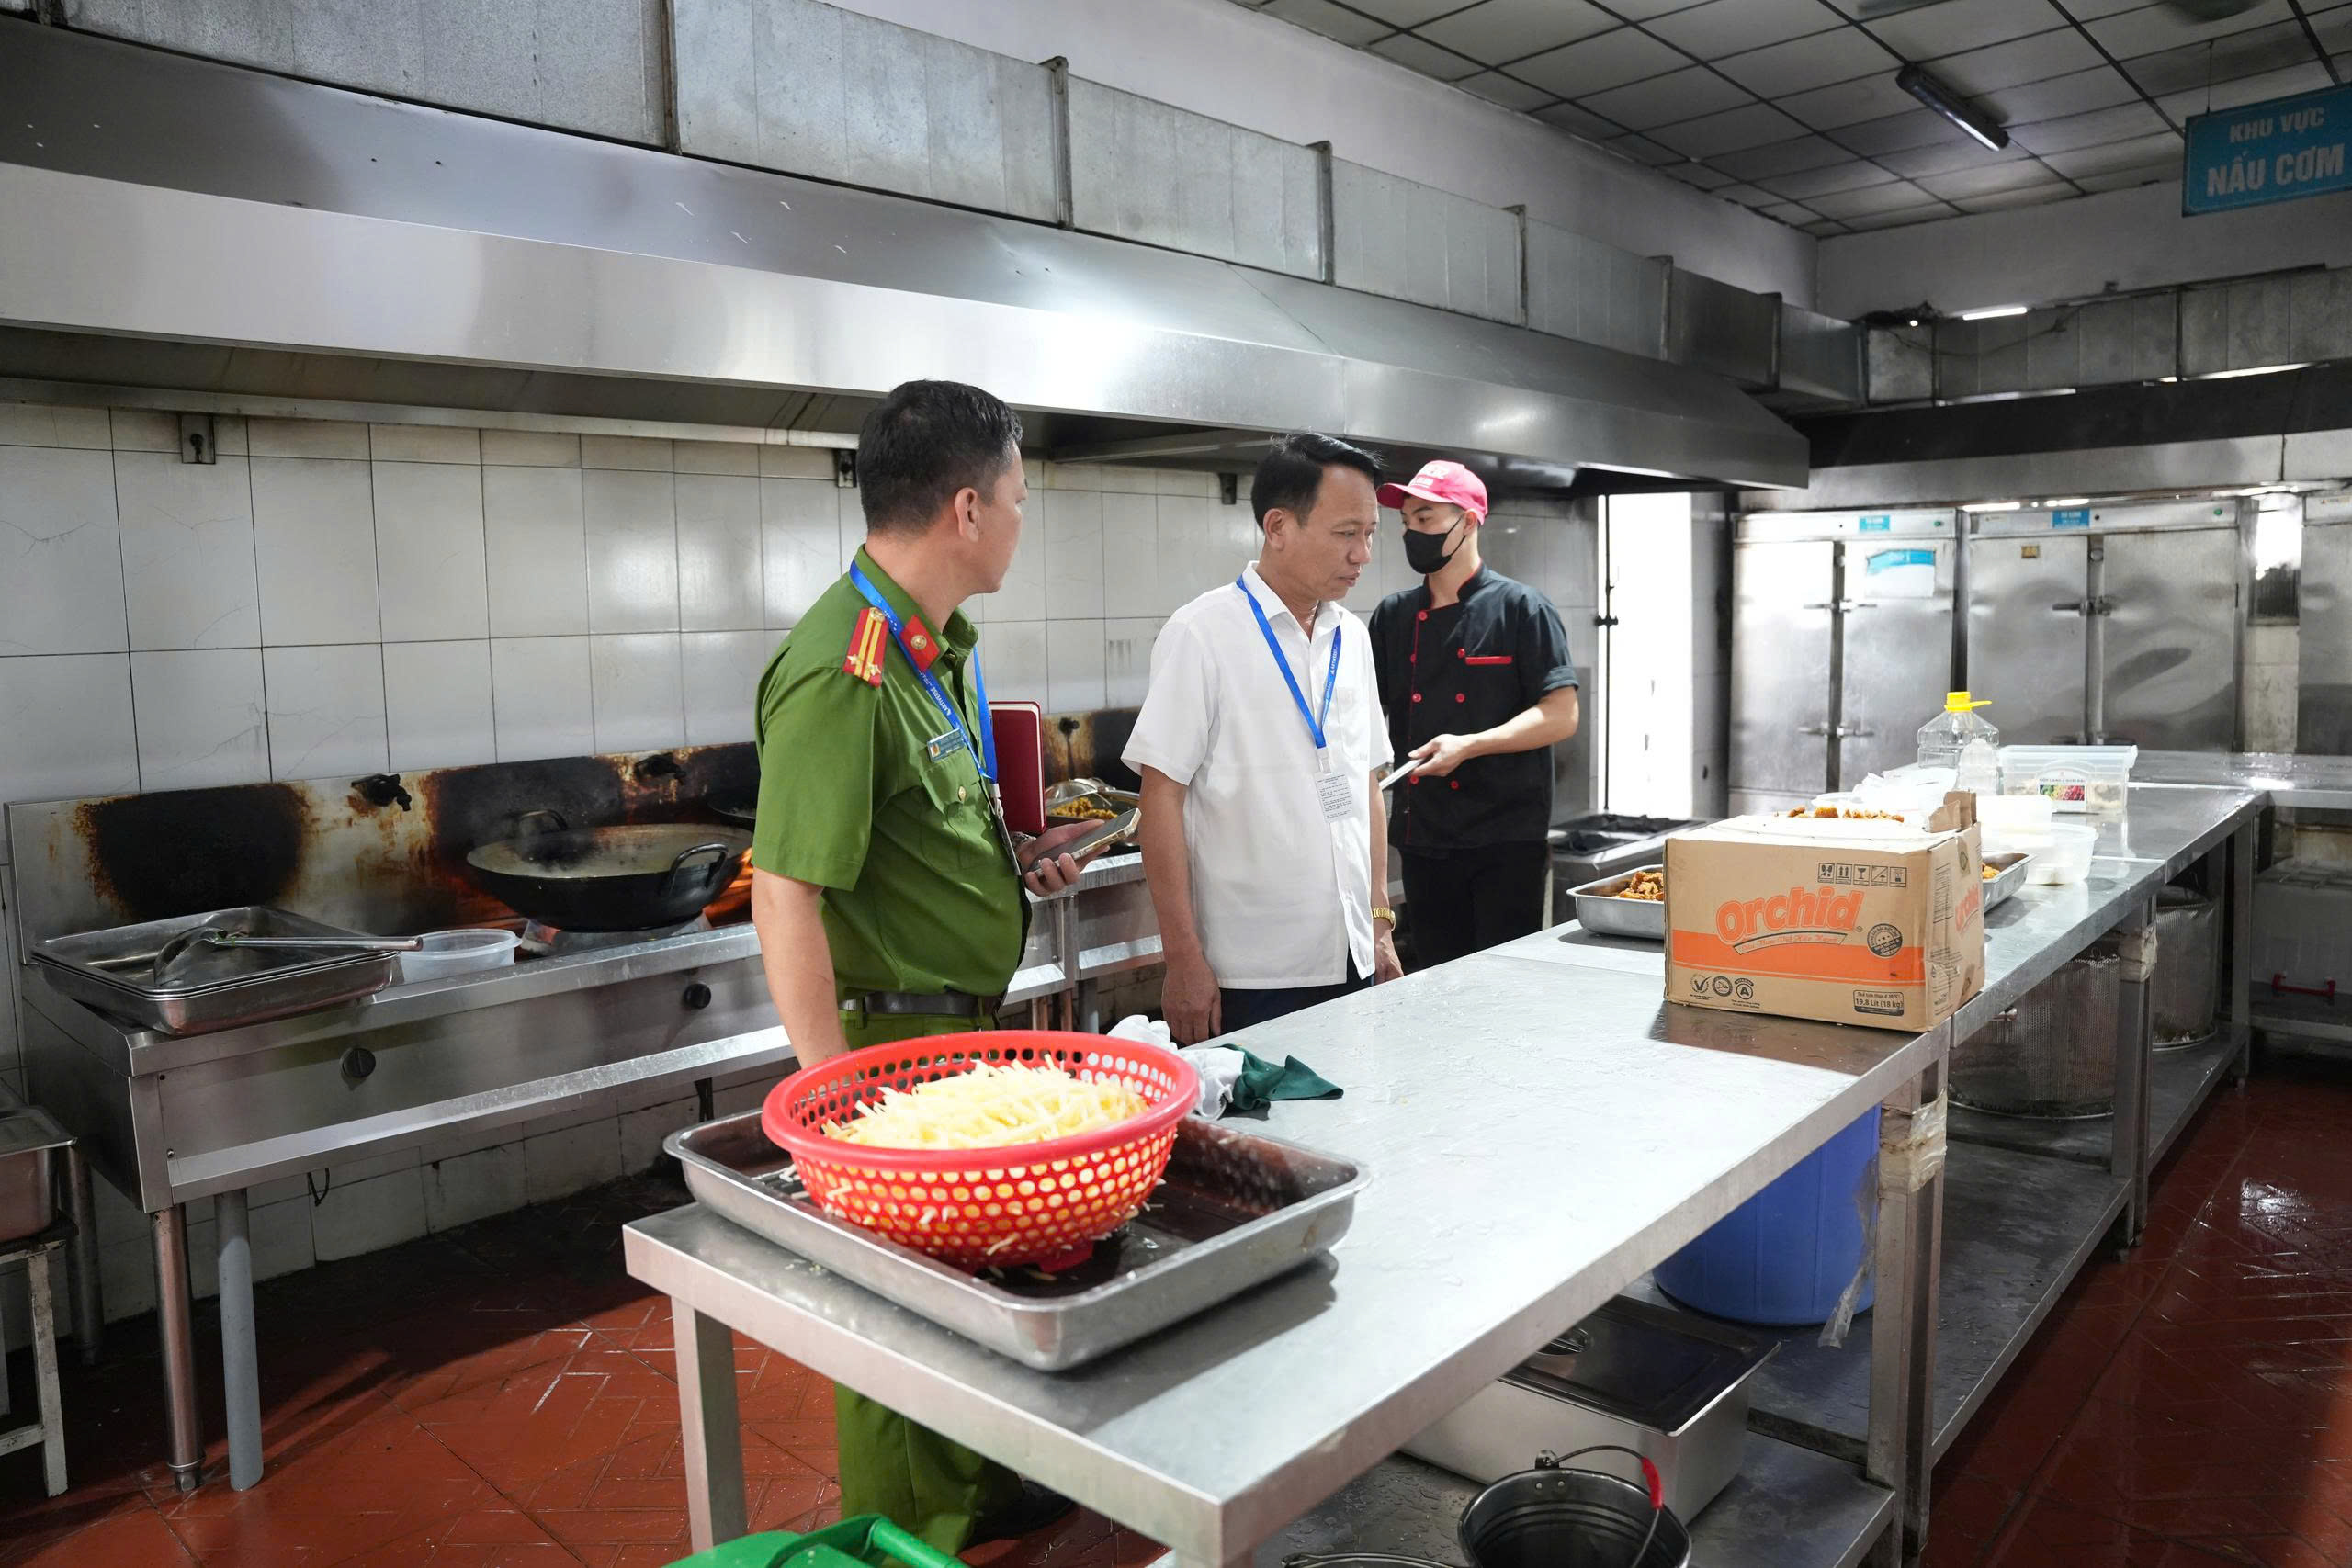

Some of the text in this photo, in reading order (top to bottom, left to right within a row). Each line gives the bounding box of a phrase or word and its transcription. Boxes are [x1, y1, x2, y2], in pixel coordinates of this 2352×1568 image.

[2230, 108, 2324, 143] KHU VỰC
[2207, 143, 2345, 197] NẤU CƠM
[1716, 886, 1866, 946] orchid
